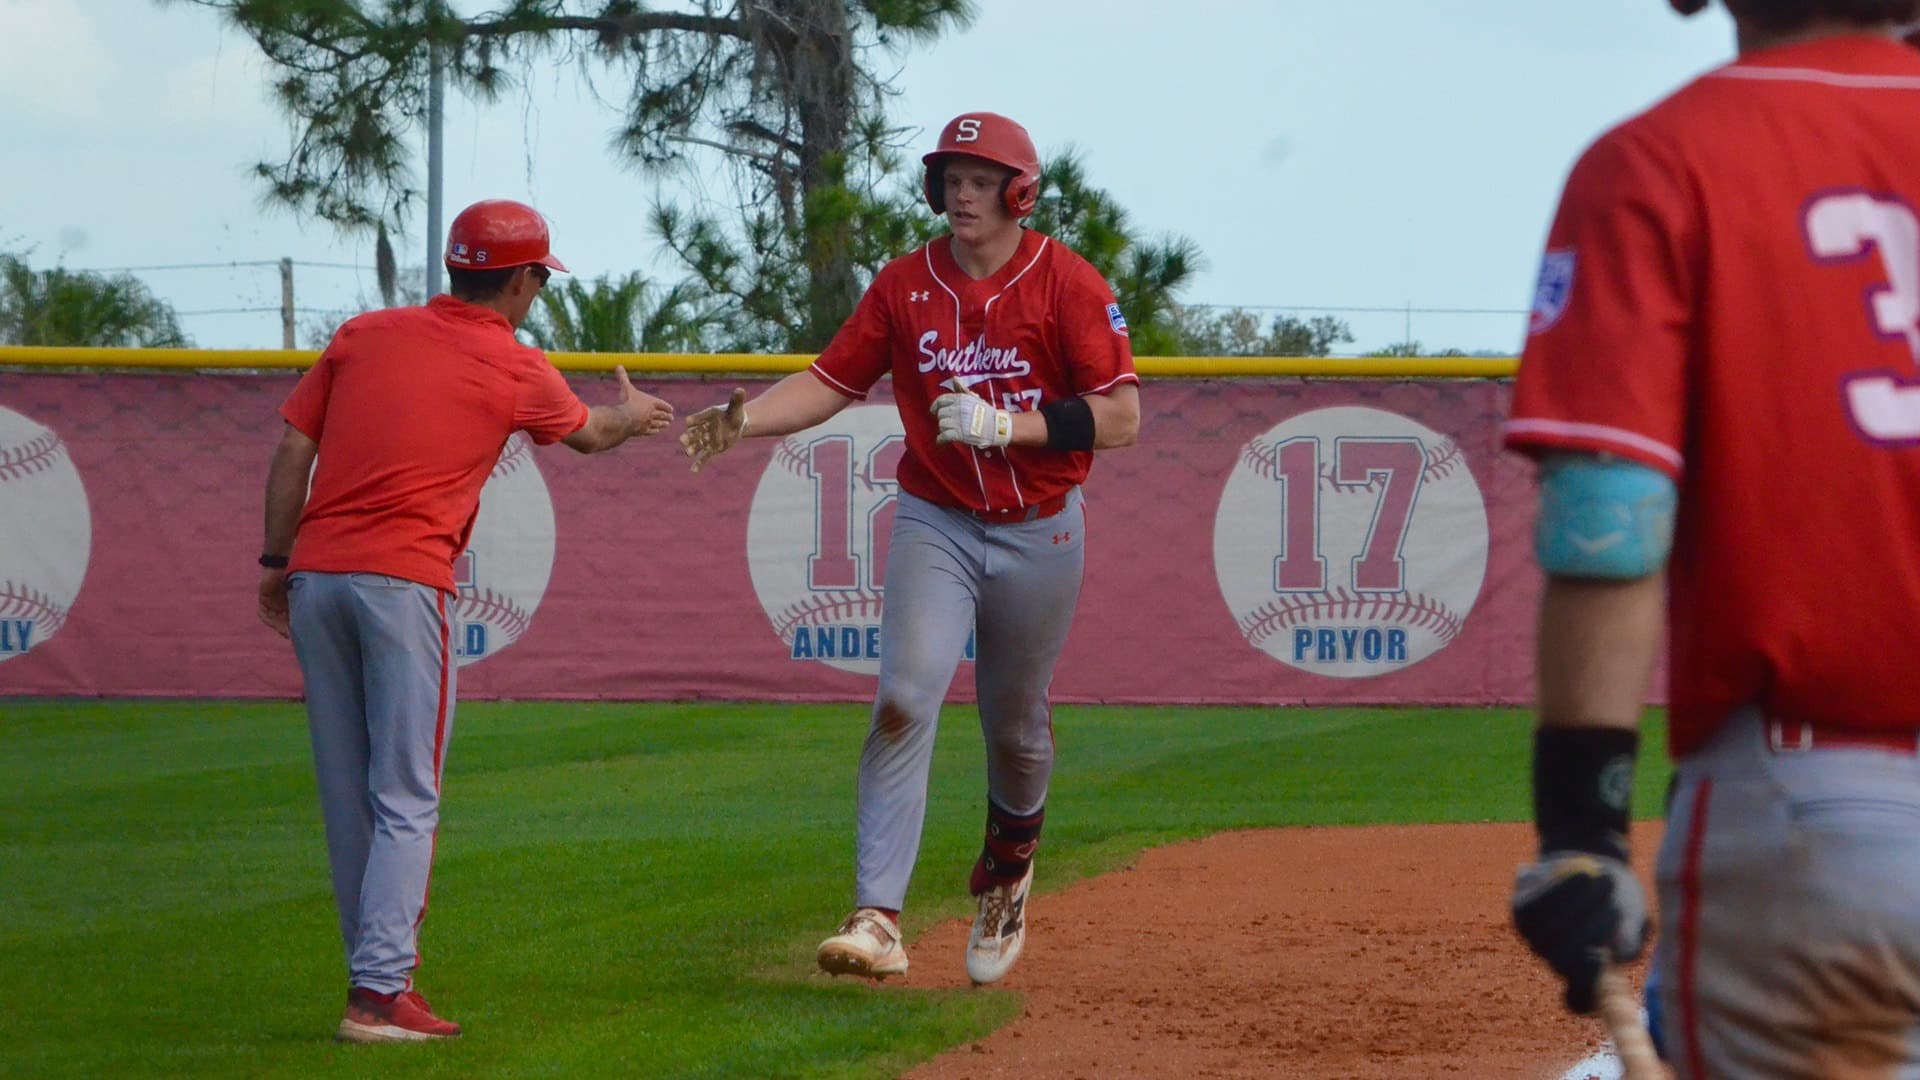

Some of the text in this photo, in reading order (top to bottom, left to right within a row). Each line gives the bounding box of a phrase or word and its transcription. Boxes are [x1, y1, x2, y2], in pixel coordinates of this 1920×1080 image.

[955, 118, 982, 142] S
[918, 330, 1030, 374] Southern
[1273, 436, 1428, 592] 17
[1295, 627, 1406, 661] PRYOR
